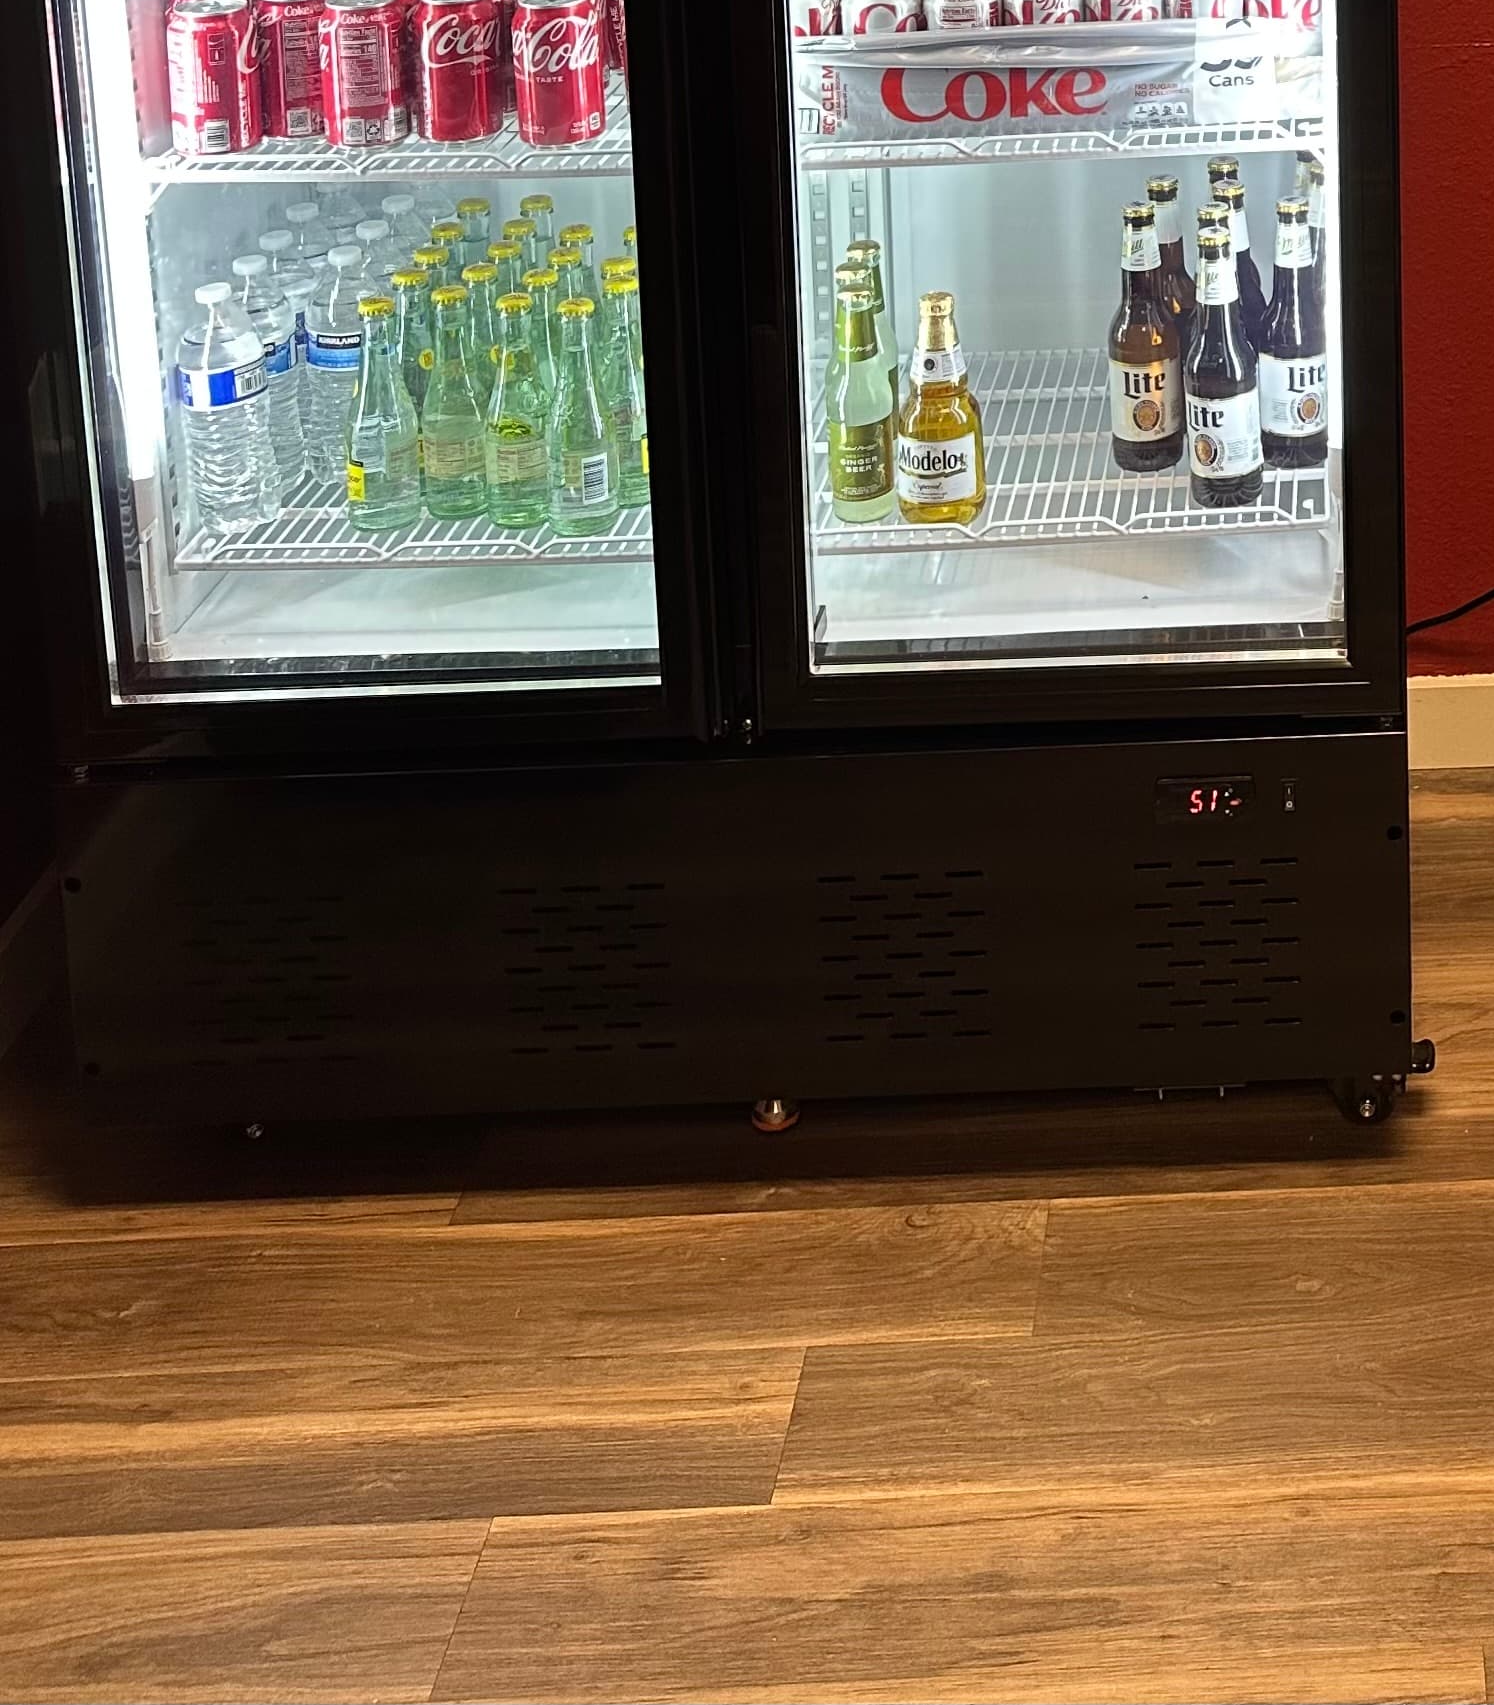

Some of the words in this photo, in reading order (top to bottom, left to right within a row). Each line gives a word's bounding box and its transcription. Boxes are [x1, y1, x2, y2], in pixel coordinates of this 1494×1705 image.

[1208, 74, 1255, 88] Cans
[822, 81, 836, 136] RECYCLE
[1122, 369, 1166, 399] Lite
[1287, 364, 1326, 393] Lite
[1188, 401, 1224, 431] Lite
[839, 455, 879, 466] GINGER
[845, 464, 873, 474] BEER
[898, 444, 958, 472] Modelo
